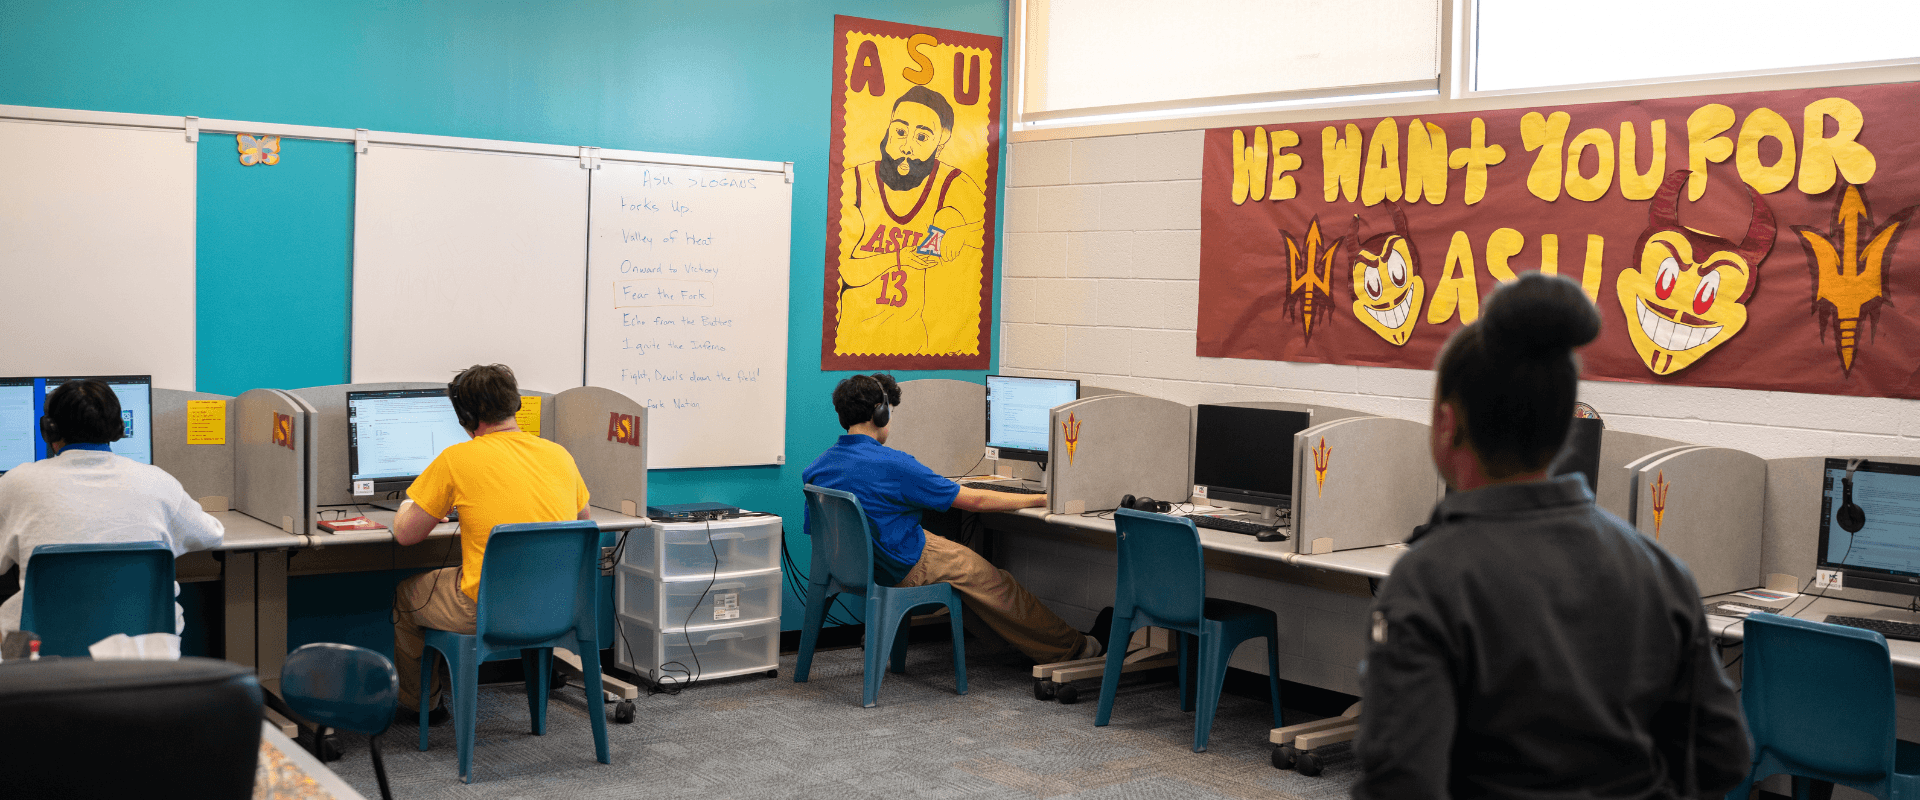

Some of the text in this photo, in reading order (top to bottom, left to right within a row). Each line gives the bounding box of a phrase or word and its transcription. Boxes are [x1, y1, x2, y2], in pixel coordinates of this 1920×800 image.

[1231, 126, 1303, 206] WE
[1520, 111, 1666, 202] YOU
[1687, 97, 1876, 202] FOR
[643, 170, 757, 189] ASU SLOGANS
[621, 196, 660, 213] Forks
[622, 229, 714, 251] Valley of Heat
[860, 224, 923, 253] ASU
[917, 225, 946, 257] A
[620, 259, 719, 279] Onward to Victory
[623, 285, 706, 300] Fear the Fork
[876, 270, 908, 308] 13
[623, 313, 733, 327] Echo from the Buttes
[622, 337, 725, 356] Ignite the Inferno
[654, 369, 684, 381] Devils
[716, 371, 731, 382] the
[673, 398, 700, 409] Nation
[607, 411, 641, 447] ASU
